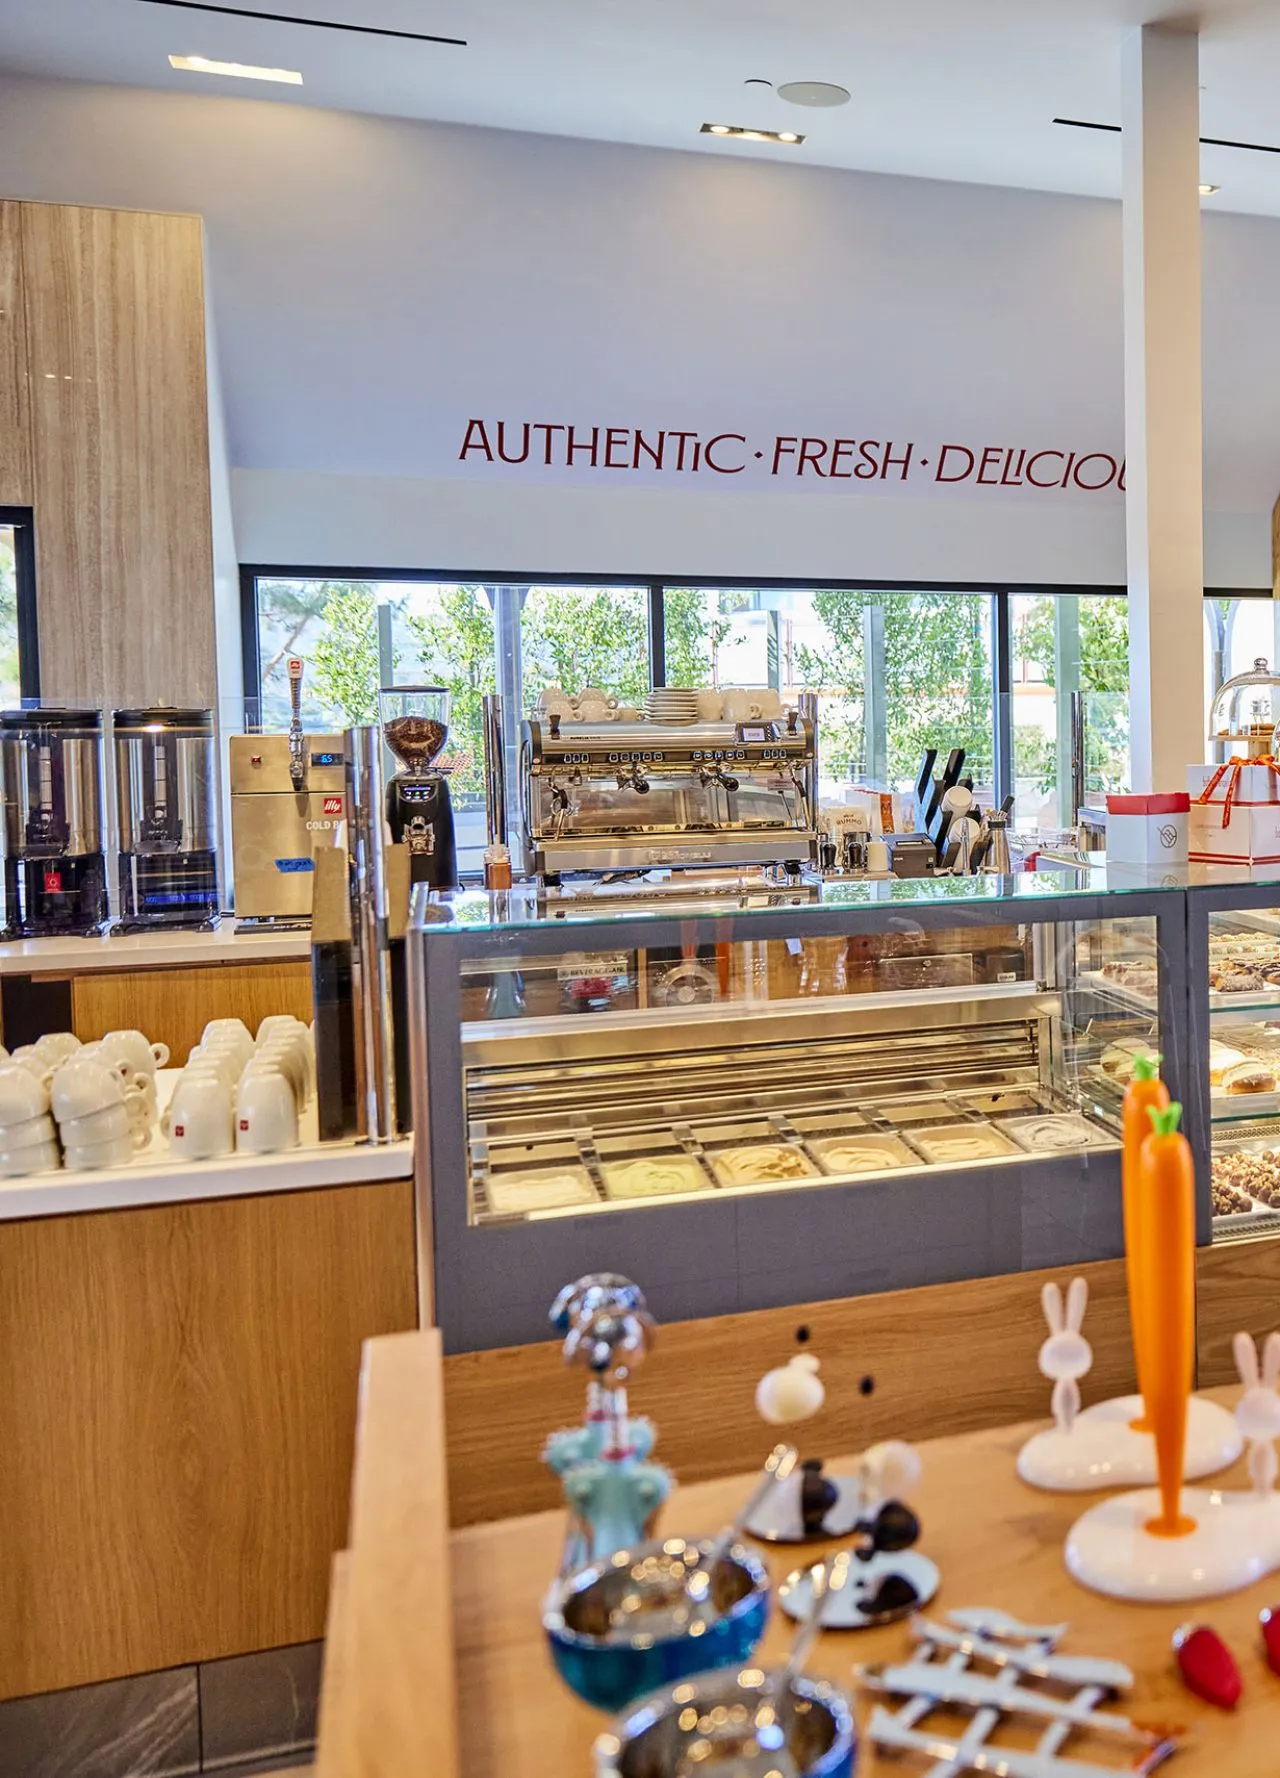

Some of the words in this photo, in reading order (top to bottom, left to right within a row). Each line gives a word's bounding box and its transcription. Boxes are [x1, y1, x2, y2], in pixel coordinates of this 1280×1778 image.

[771, 436, 915, 481] FRESH
[324, 799, 341, 813] illy
[305, 820, 331, 831] COLD
